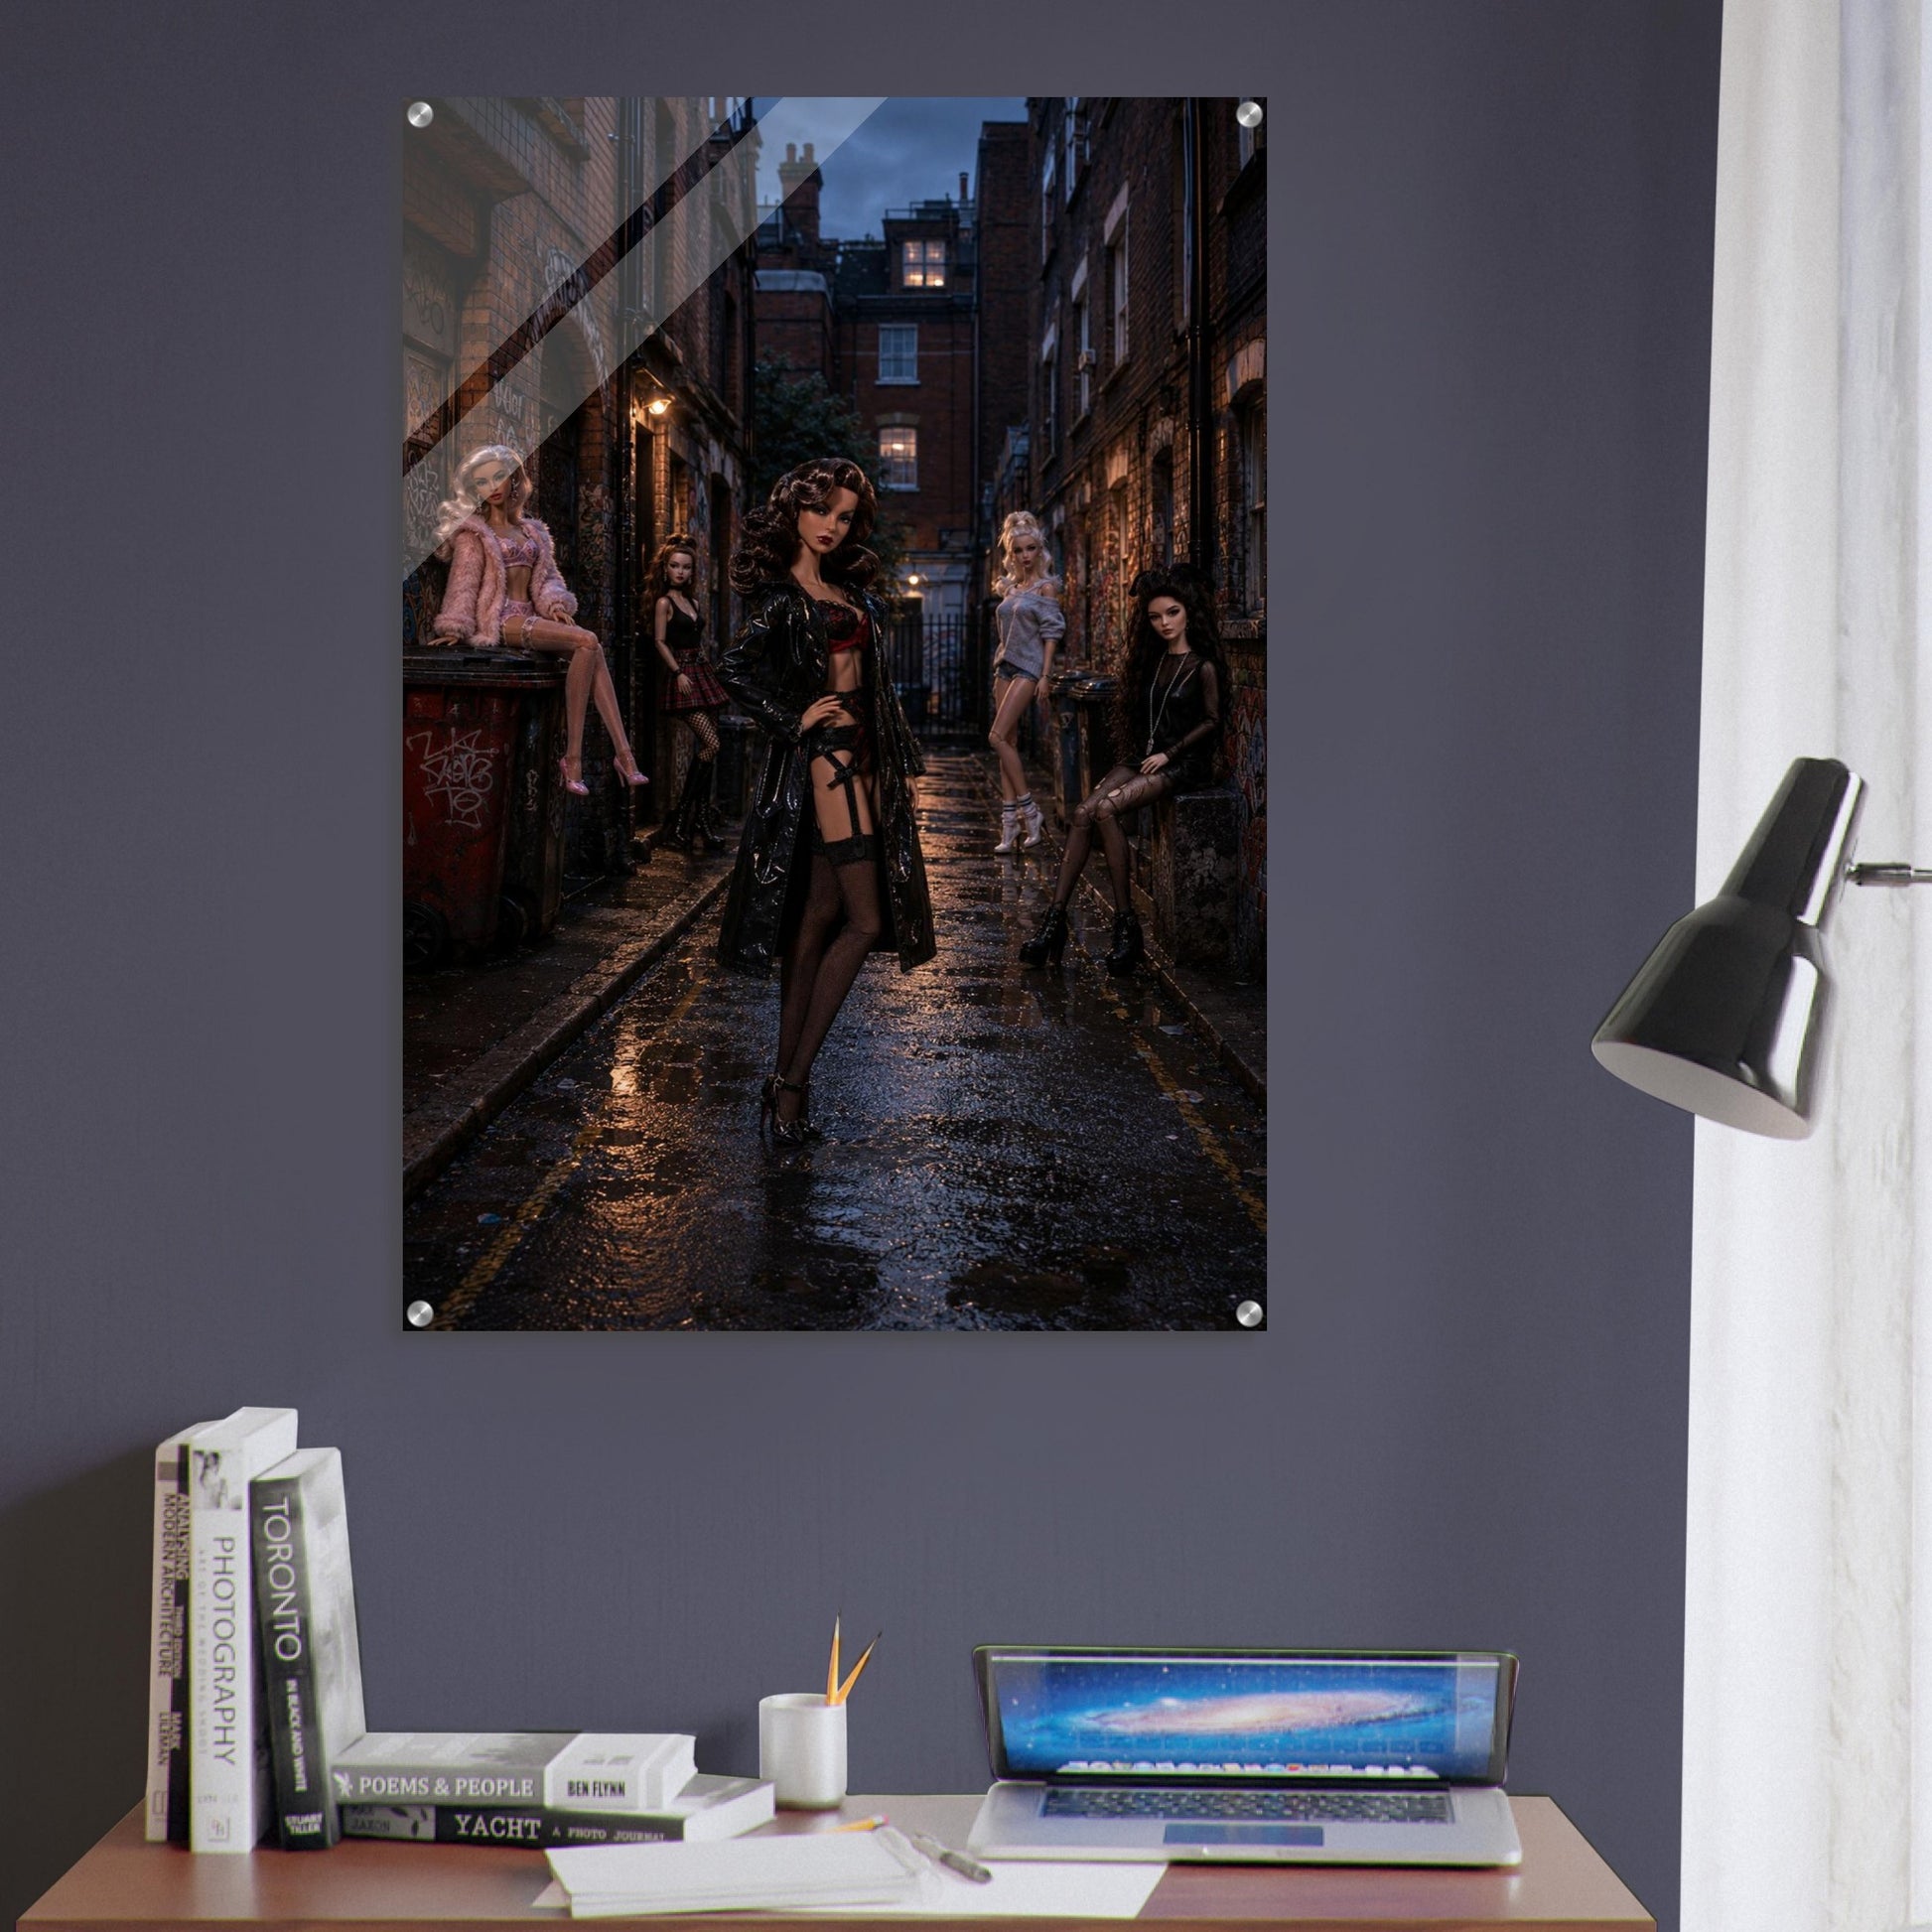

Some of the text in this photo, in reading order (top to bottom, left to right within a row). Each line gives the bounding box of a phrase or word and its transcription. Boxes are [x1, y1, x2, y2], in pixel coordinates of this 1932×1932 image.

[177, 1492, 191, 1581] ANALYSING
[159, 1493, 177, 1678] MODERN ARCHITECTURE
[261, 1497, 302, 1661] TORONTO
[212, 1536, 236, 1766] PHOTOGRAPHY
[287, 1693, 302, 1728] BLACK
[170, 1711, 183, 1749] MARK
[290, 1729, 304, 1756] AND
[293, 1756, 308, 1792] WHITE
[359, 1776, 534, 1797] POEMS & PEOPLE
[567, 1780, 625, 1797] BEN FLYNN
[454, 1813, 541, 1840] YACHT
[552, 1826, 561, 1838] A
[567, 1827, 607, 1840] PHOTO
